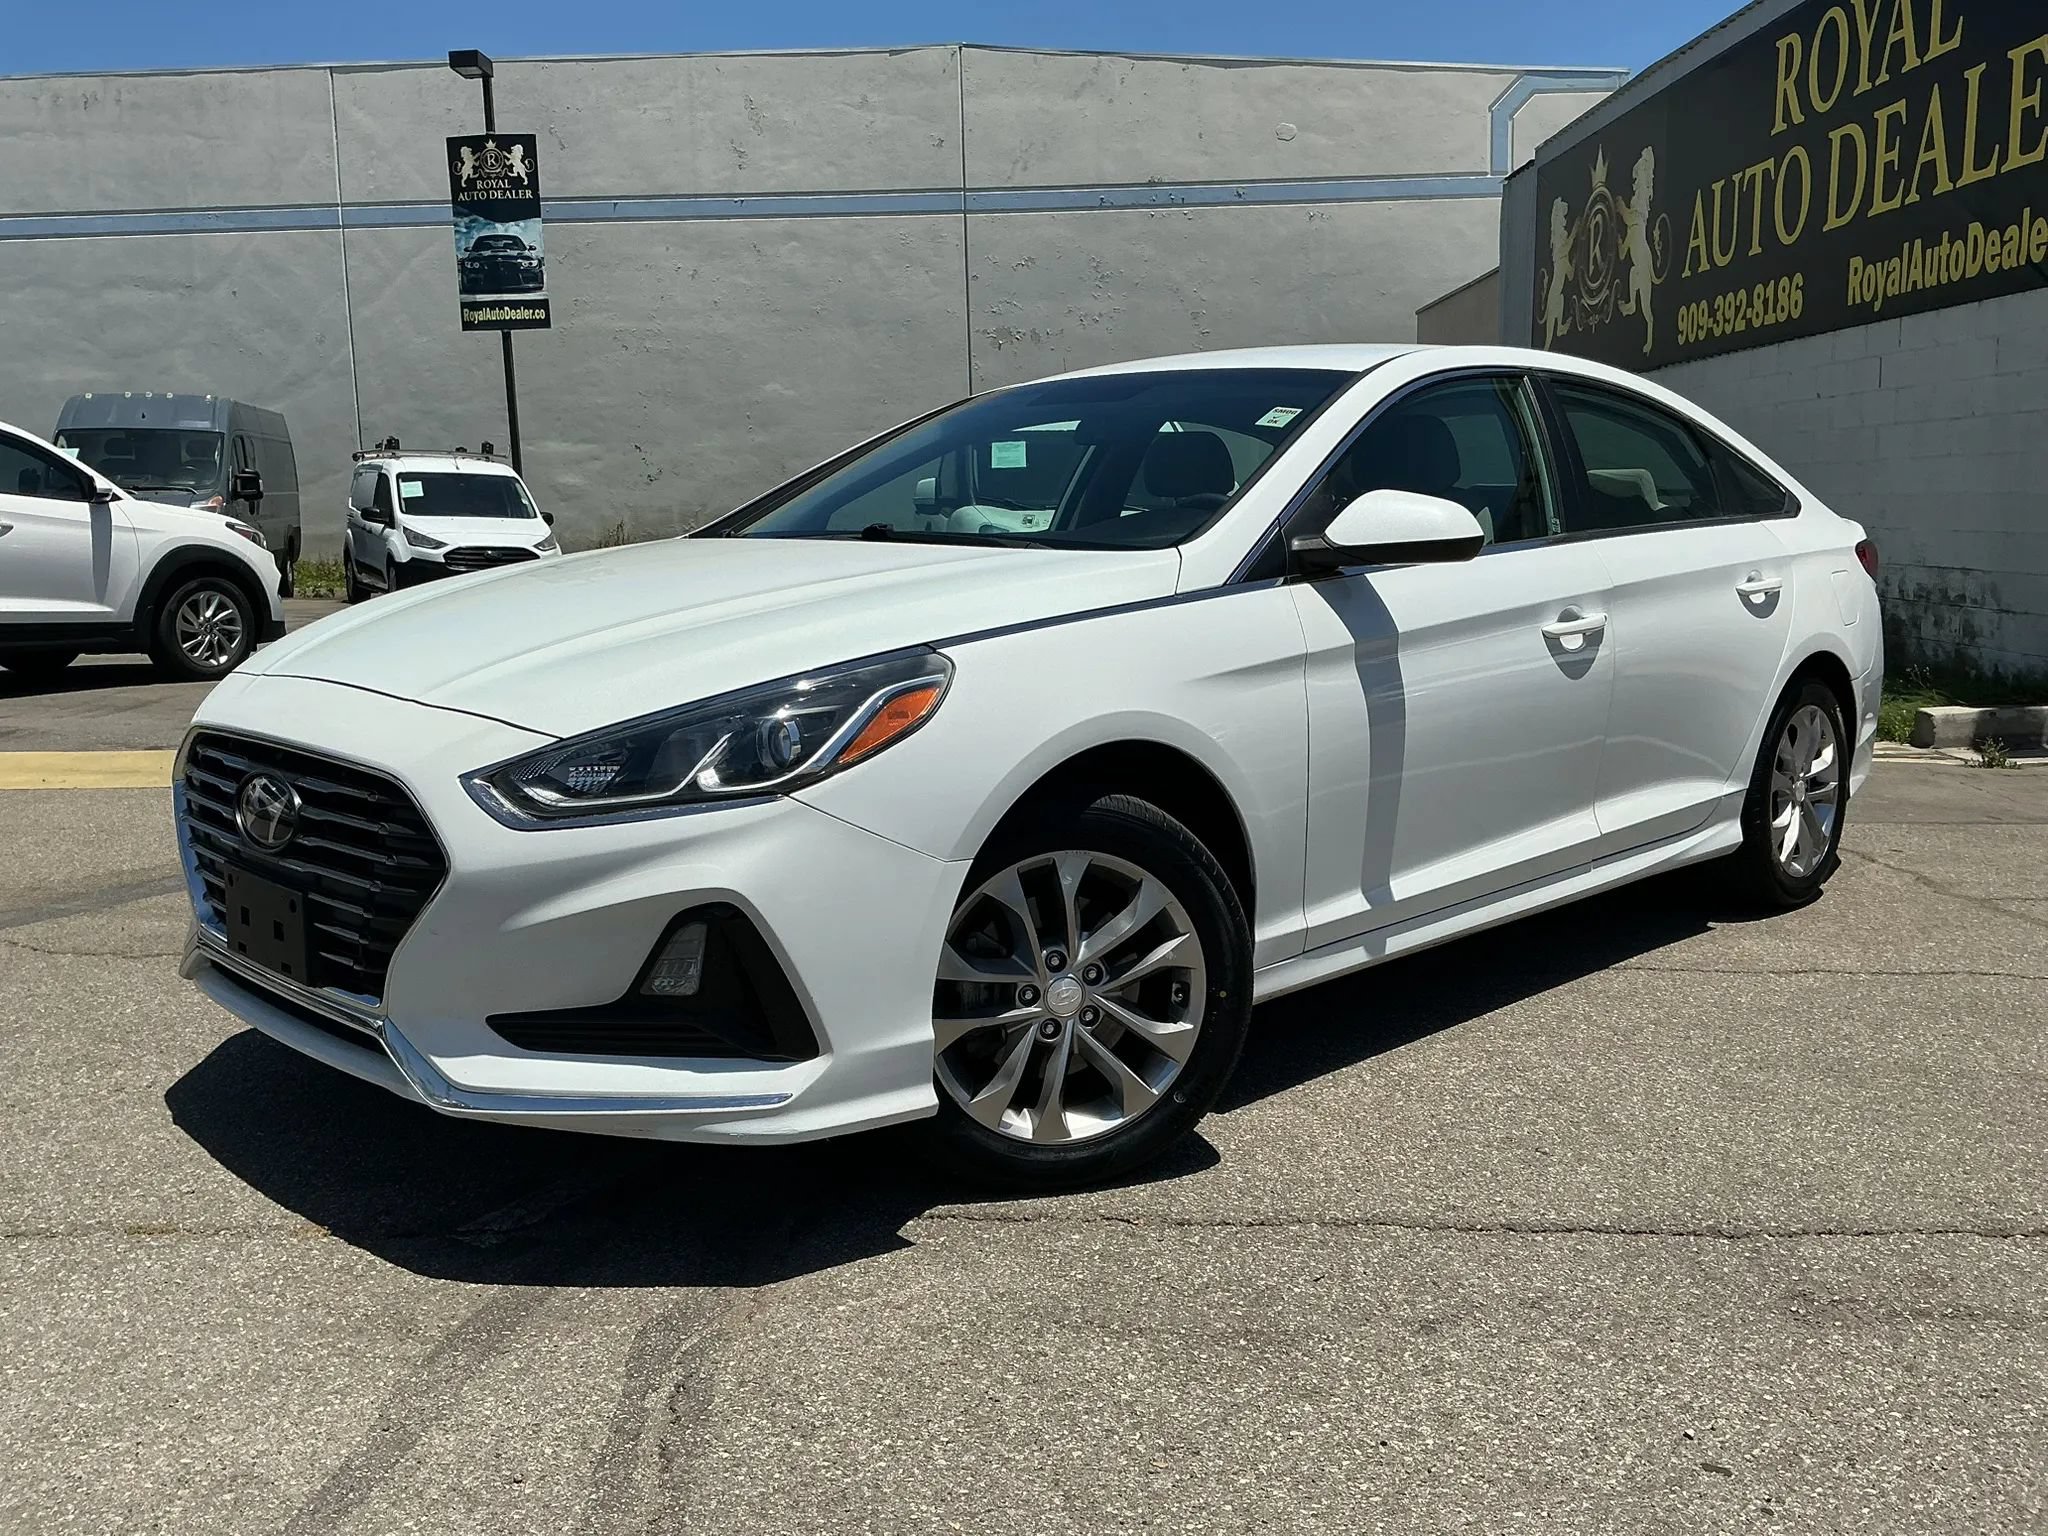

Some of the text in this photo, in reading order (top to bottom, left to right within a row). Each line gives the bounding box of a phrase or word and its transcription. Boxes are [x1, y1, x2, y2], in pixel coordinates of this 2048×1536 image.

[1771, 0, 1964, 136] ROYAL
[476, 179, 511, 190] ROYAL
[1682, 34, 2048, 278] AUTO DEALE
[458, 189, 533, 201] AUTO DEALER
[1848, 206, 2048, 312] RoyalAutoDeale
[463, 306, 546, 324] RoyalAutoDealer.co
[1678, 272, 1804, 345] 909-392-8186
